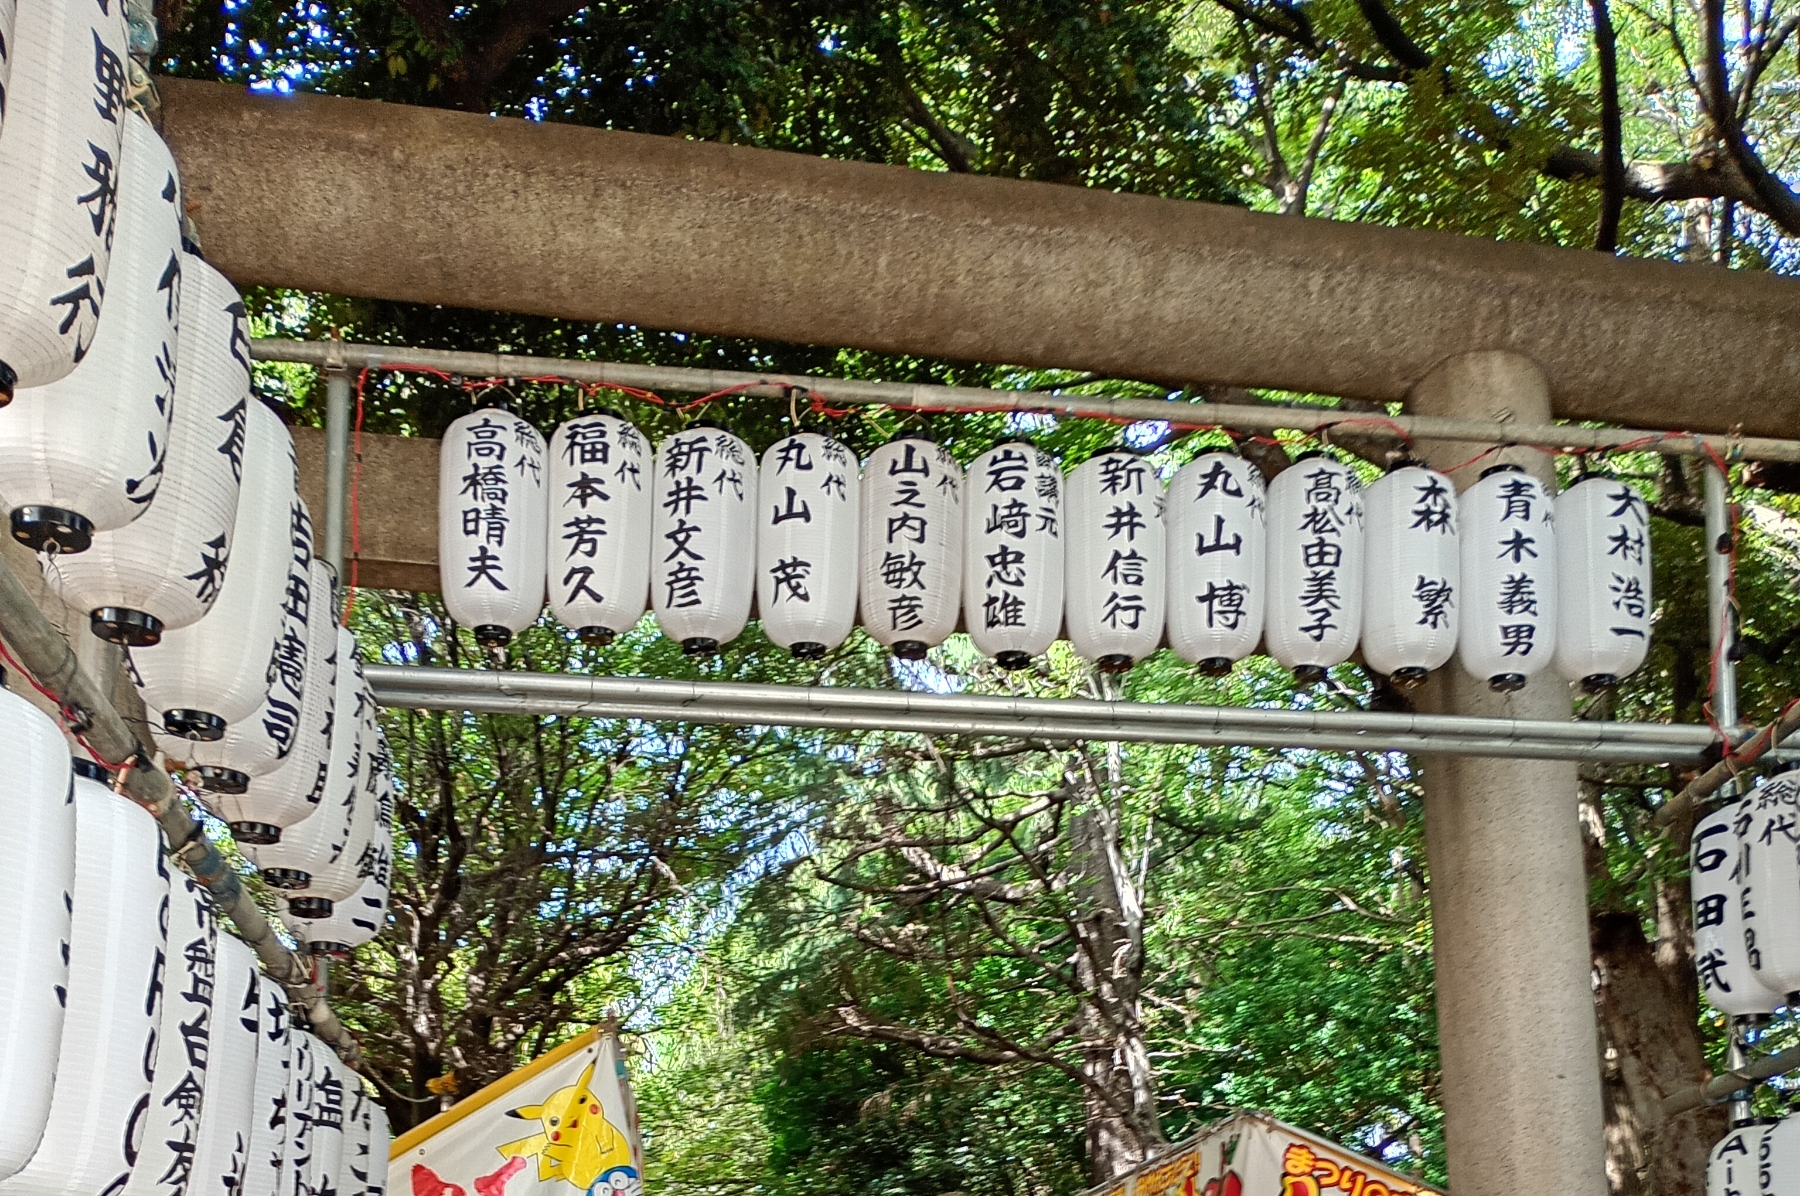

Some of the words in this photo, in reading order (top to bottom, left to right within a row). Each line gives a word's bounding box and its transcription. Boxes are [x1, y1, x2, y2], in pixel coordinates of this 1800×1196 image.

[461, 418, 510, 592] 高橋晴夫
[561, 422, 610, 607] 福本芳久
[664, 435, 710, 610] 新井文彦
[770, 437, 813, 604] 丸山茂
[879, 443, 931, 632] 山之内敏彦
[1099, 456, 1148, 631] 新井信行
[1194, 460, 1250, 631] 丸山博
[1495, 477, 1539, 658] 青木義男
[1606, 485, 1647, 642] 大村浩一
[1692, 823, 1732, 995] 石田武
